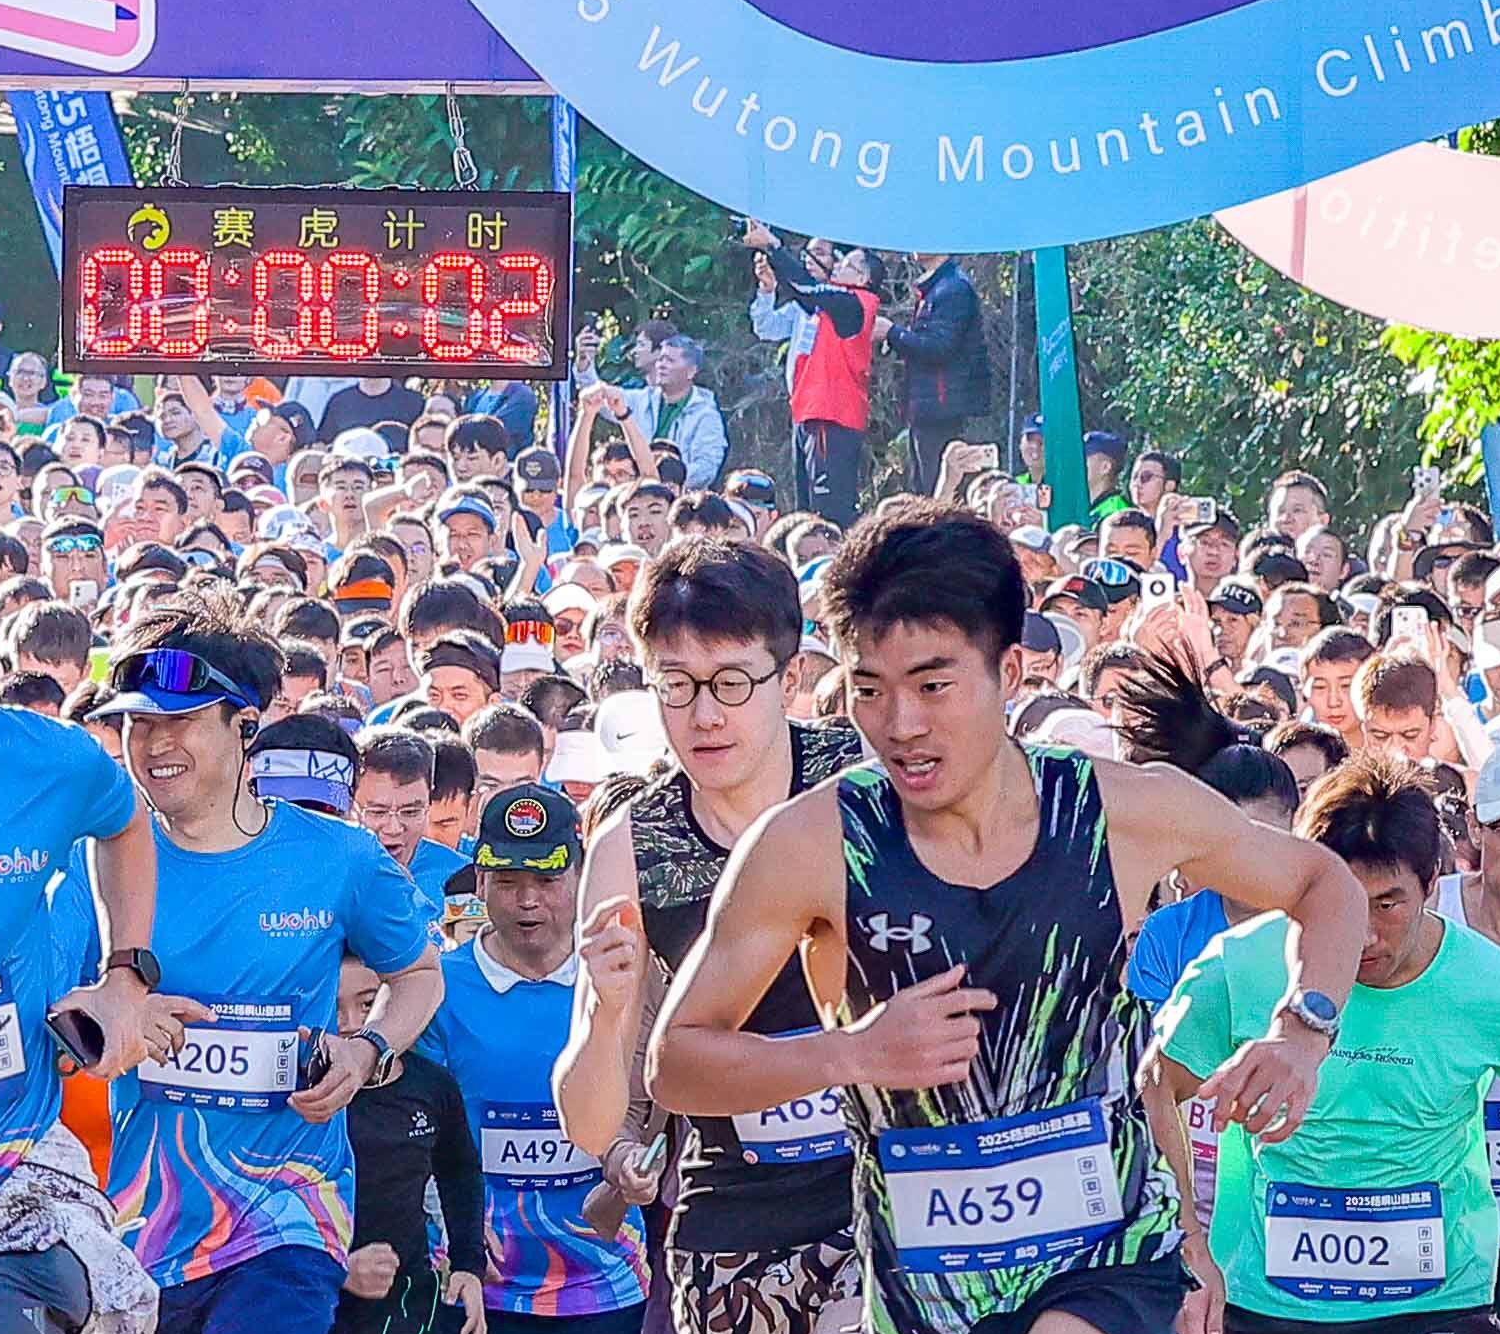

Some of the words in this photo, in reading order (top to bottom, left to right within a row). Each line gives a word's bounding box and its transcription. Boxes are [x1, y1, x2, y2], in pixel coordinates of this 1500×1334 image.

[635, 26, 892, 189] Wutong
[938, 88, 1281, 183] Mountain
[211, 208, 508, 251] 赛虎计时
[82, 247, 552, 359] 00:00:02
[165, 1043, 250, 1075] A205
[500, 1137, 575, 1165] A497
[925, 1176, 1044, 1228] A639
[1291, 1231, 1391, 1267] A002
